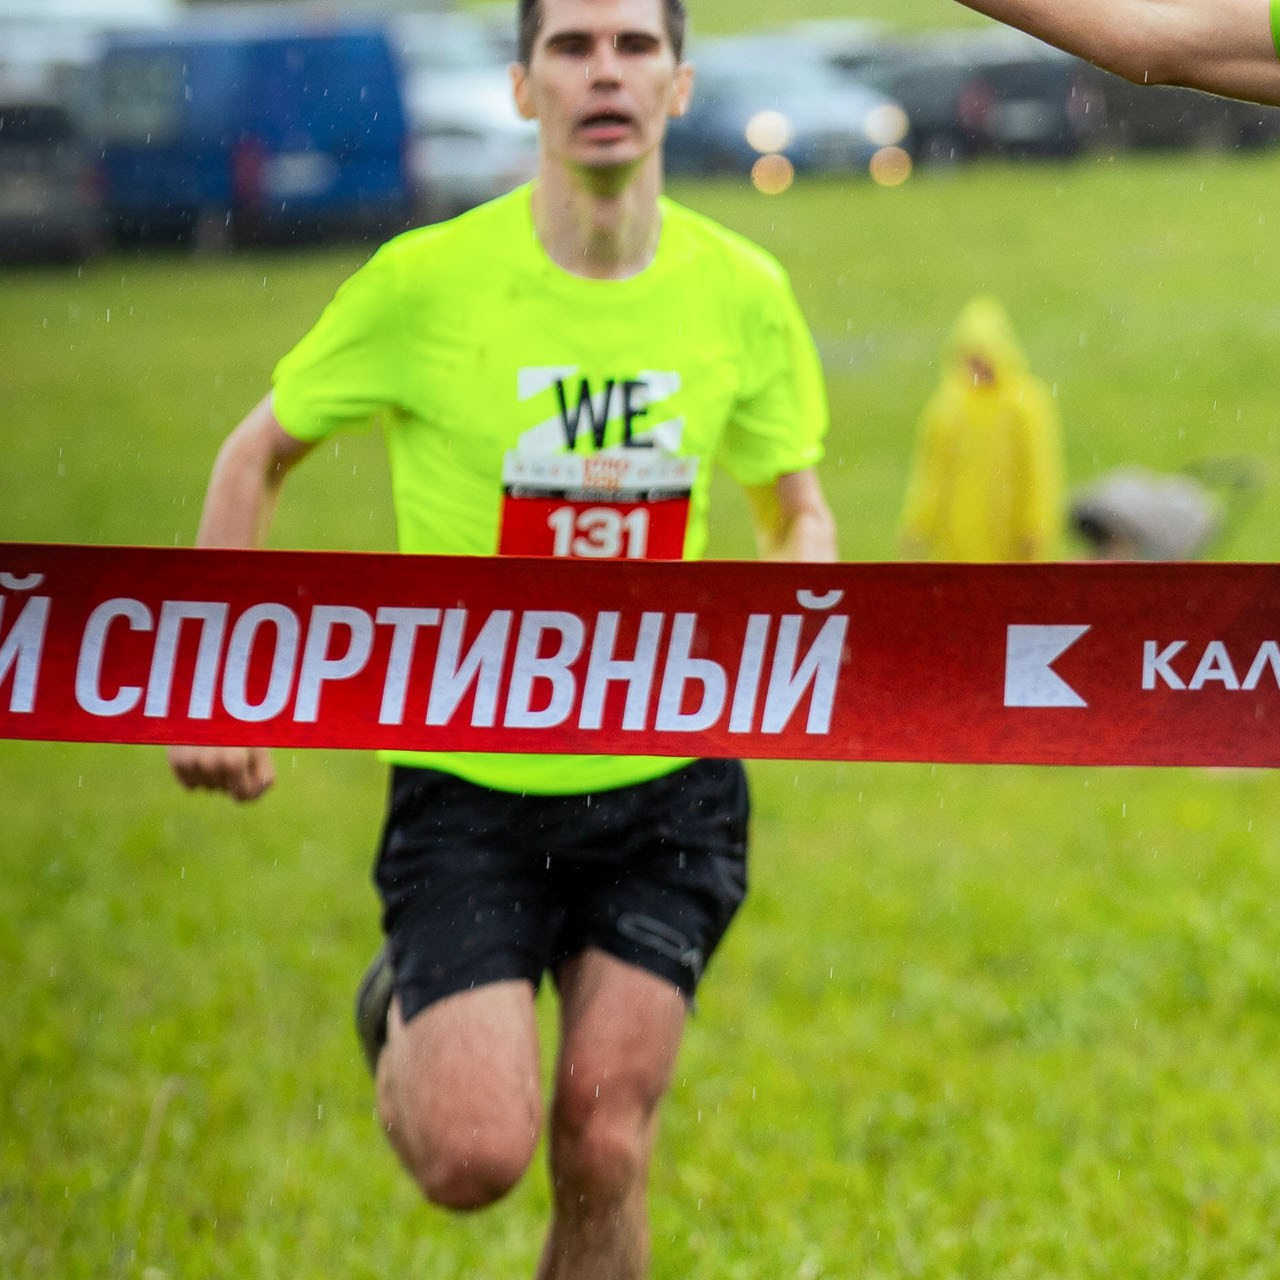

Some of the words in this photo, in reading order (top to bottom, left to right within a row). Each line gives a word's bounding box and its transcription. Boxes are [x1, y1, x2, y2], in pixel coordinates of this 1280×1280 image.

[554, 378, 654, 451] WE
[547, 505, 650, 559] 131
[75, 588, 848, 736] СПОРТИВНЫЙ
